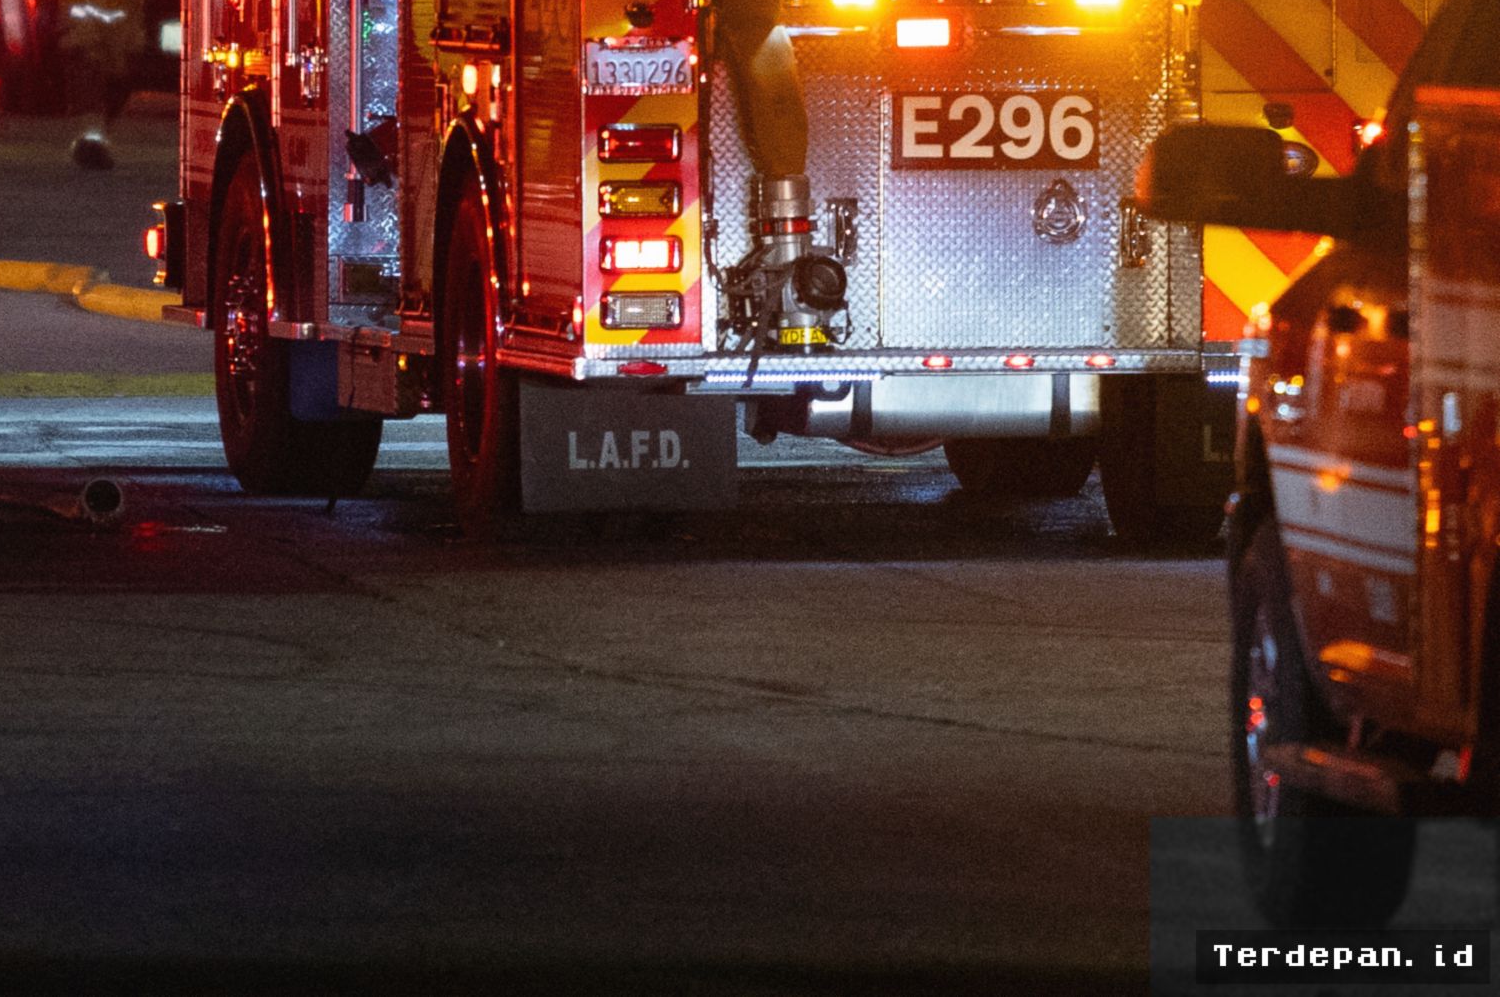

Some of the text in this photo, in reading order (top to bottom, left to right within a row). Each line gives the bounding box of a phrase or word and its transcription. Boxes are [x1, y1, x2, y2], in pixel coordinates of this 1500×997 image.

[591, 59, 688, 86] 1330296
[901, 94, 1095, 161] E296
[567, 429, 690, 470] L.A.F.D.
